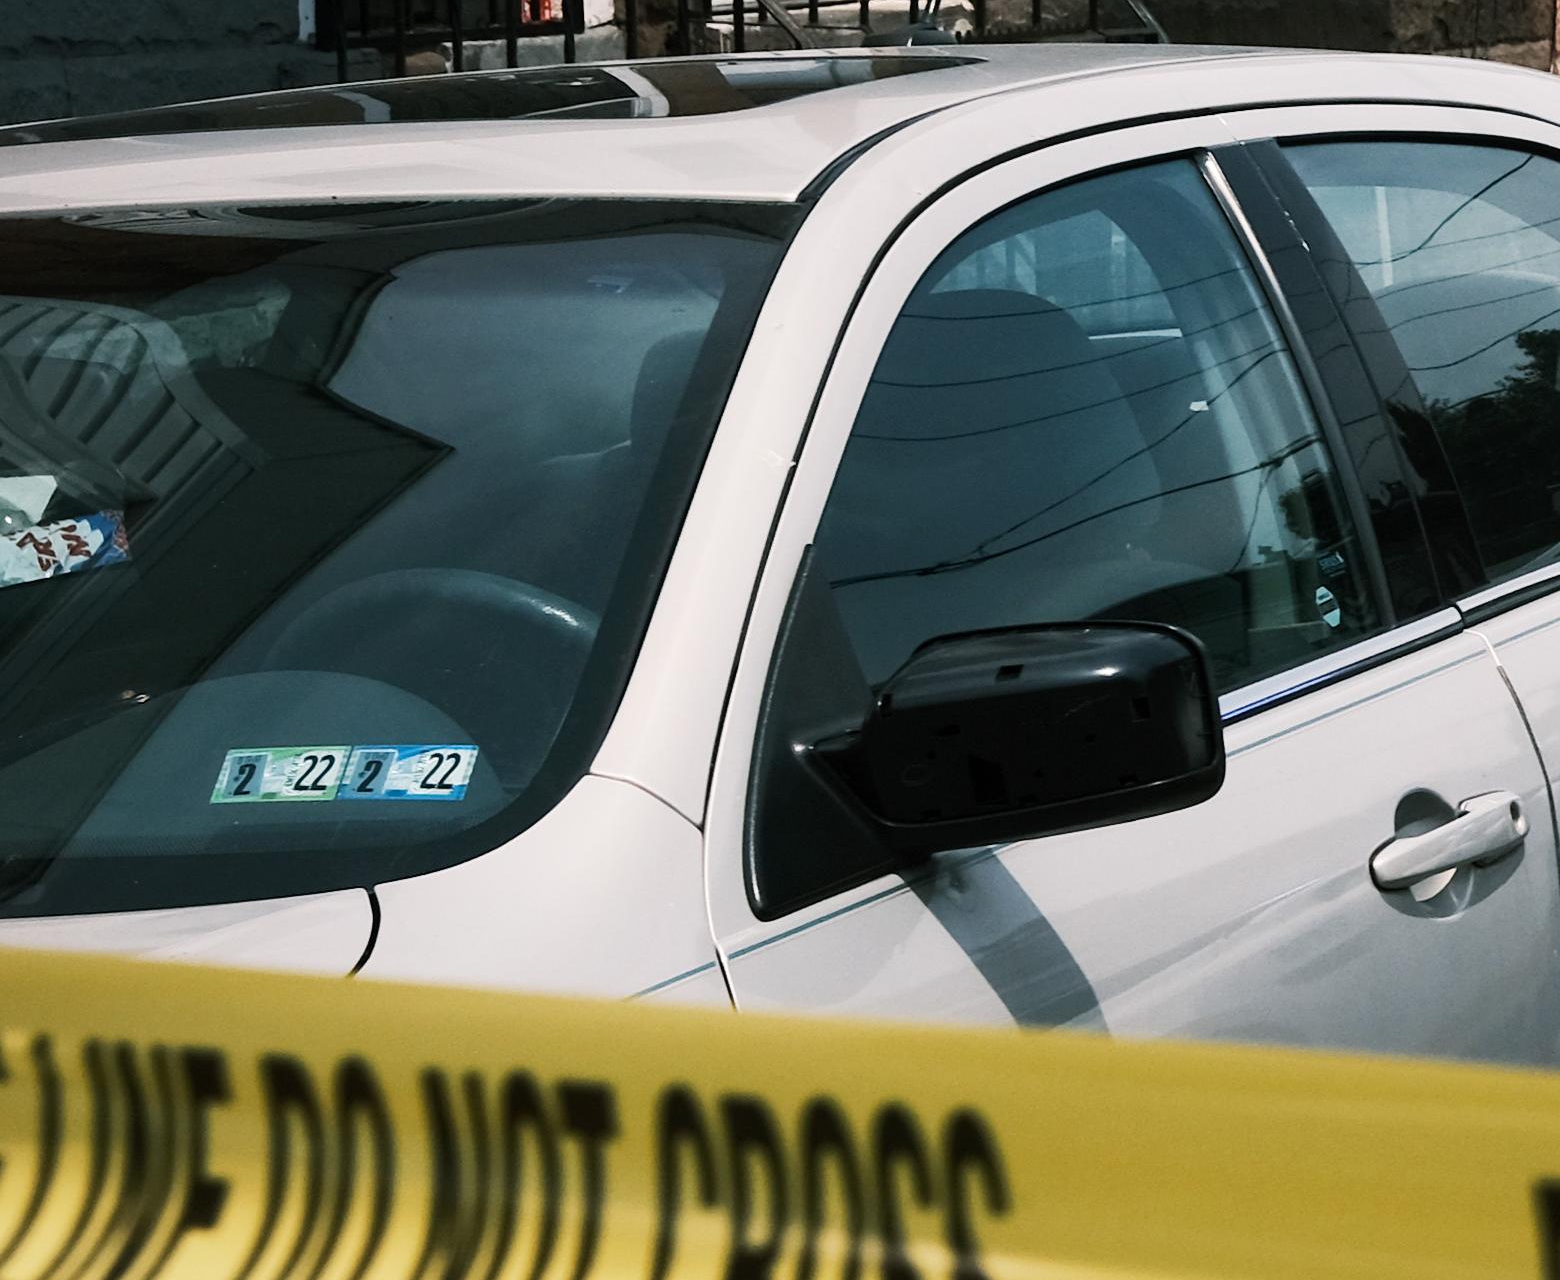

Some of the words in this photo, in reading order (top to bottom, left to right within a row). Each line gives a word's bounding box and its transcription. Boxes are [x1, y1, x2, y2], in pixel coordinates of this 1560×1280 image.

[233, 763, 257, 796] 2
[293, 754, 336, 791] 22
[357, 760, 383, 792] 2
[420, 752, 461, 789] 22
